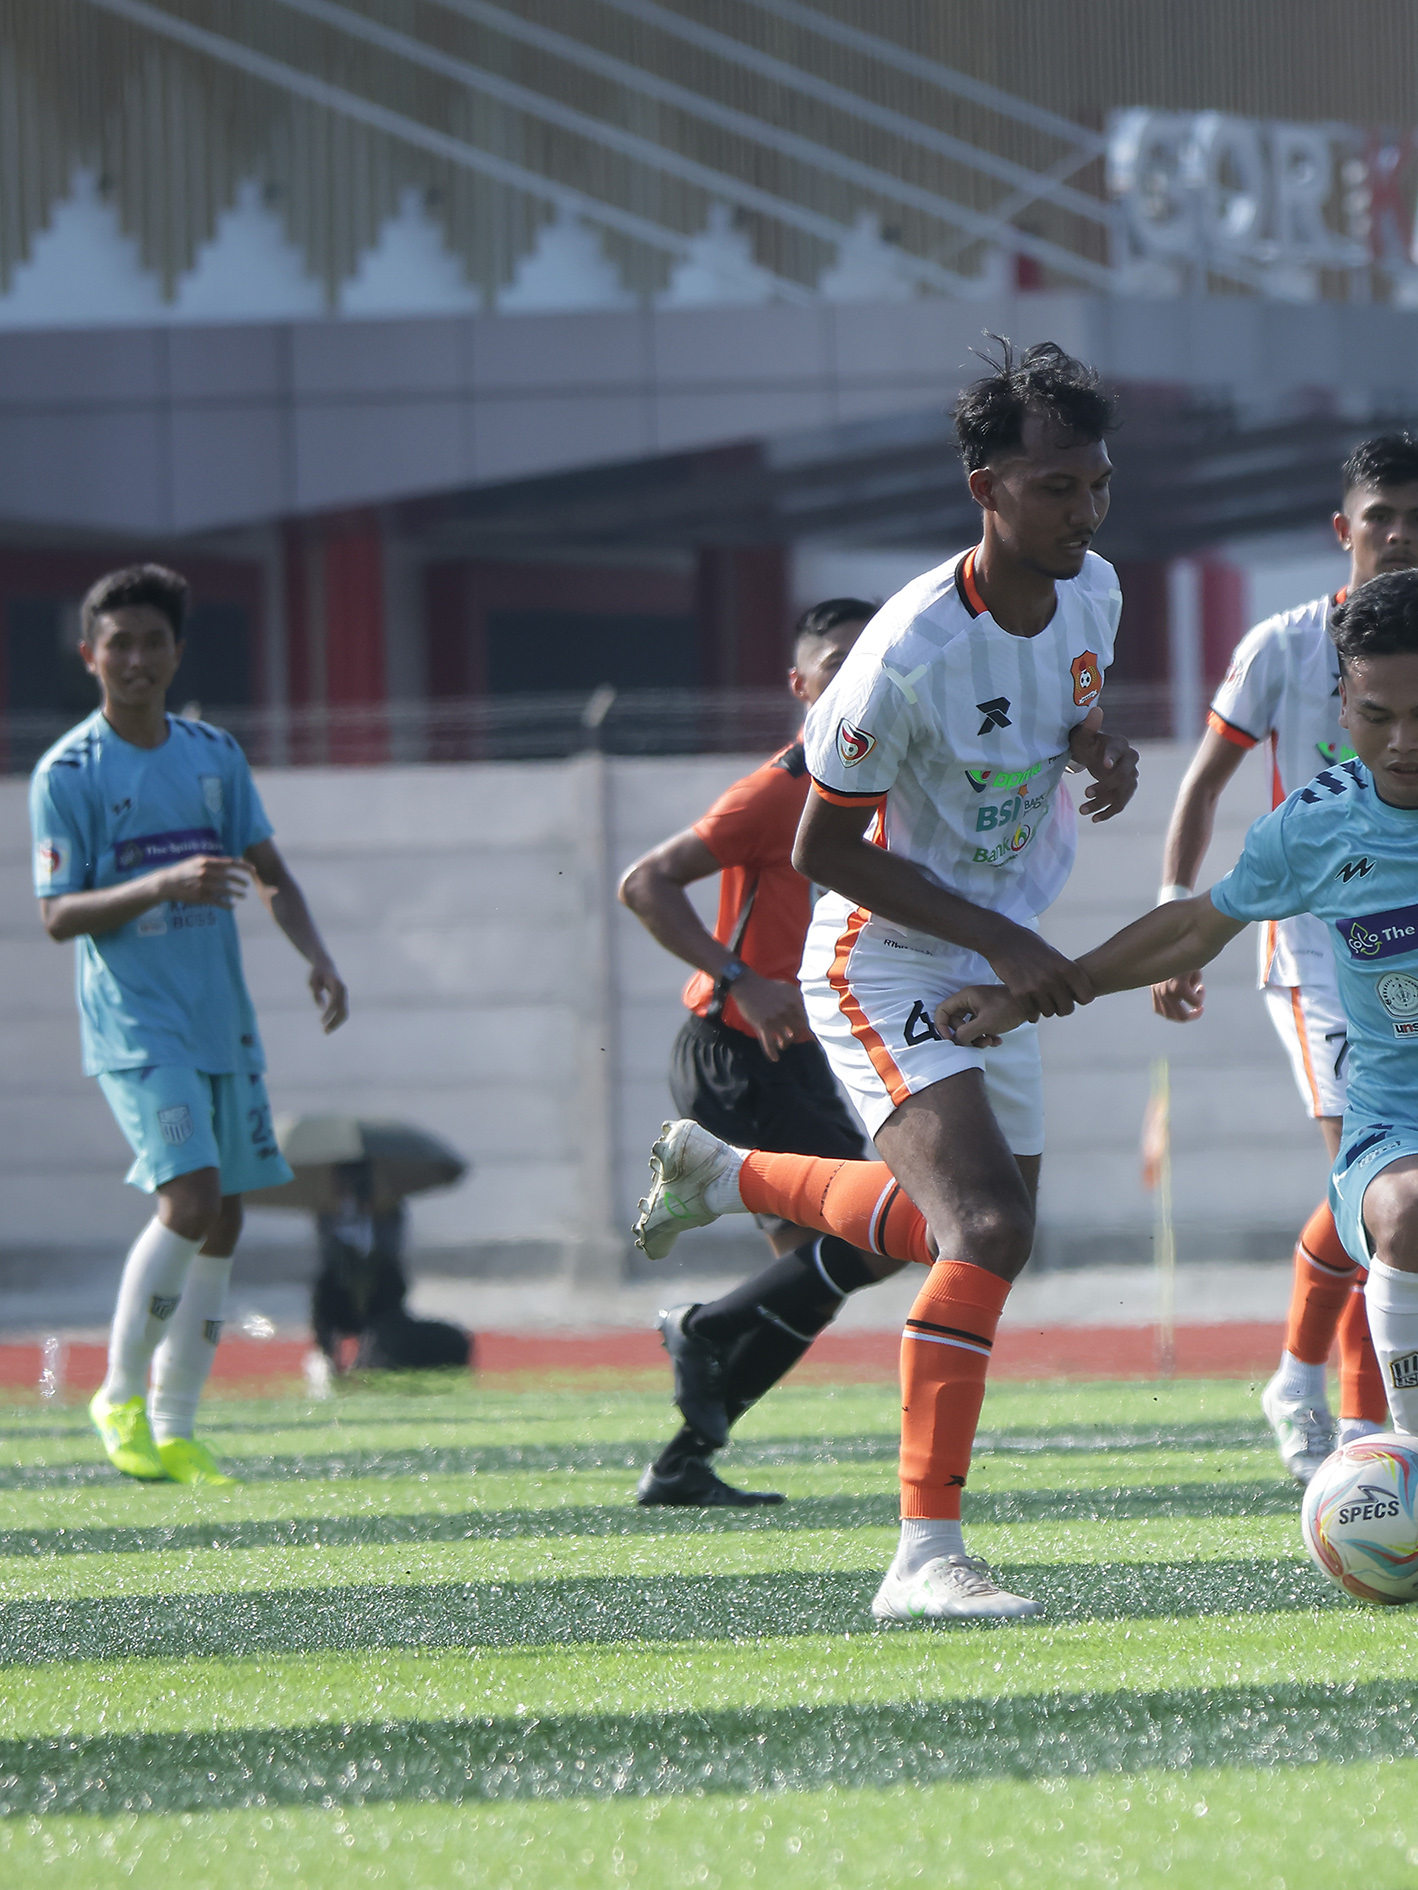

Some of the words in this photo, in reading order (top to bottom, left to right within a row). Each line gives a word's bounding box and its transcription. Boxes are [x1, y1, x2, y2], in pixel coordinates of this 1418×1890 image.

[976, 797, 1020, 832] BSI
[973, 837, 1011, 863] Bank
[1382, 926, 1416, 941] The
[904, 1000, 943, 1047] 4
[1339, 1501, 1399, 1525] SPECS
